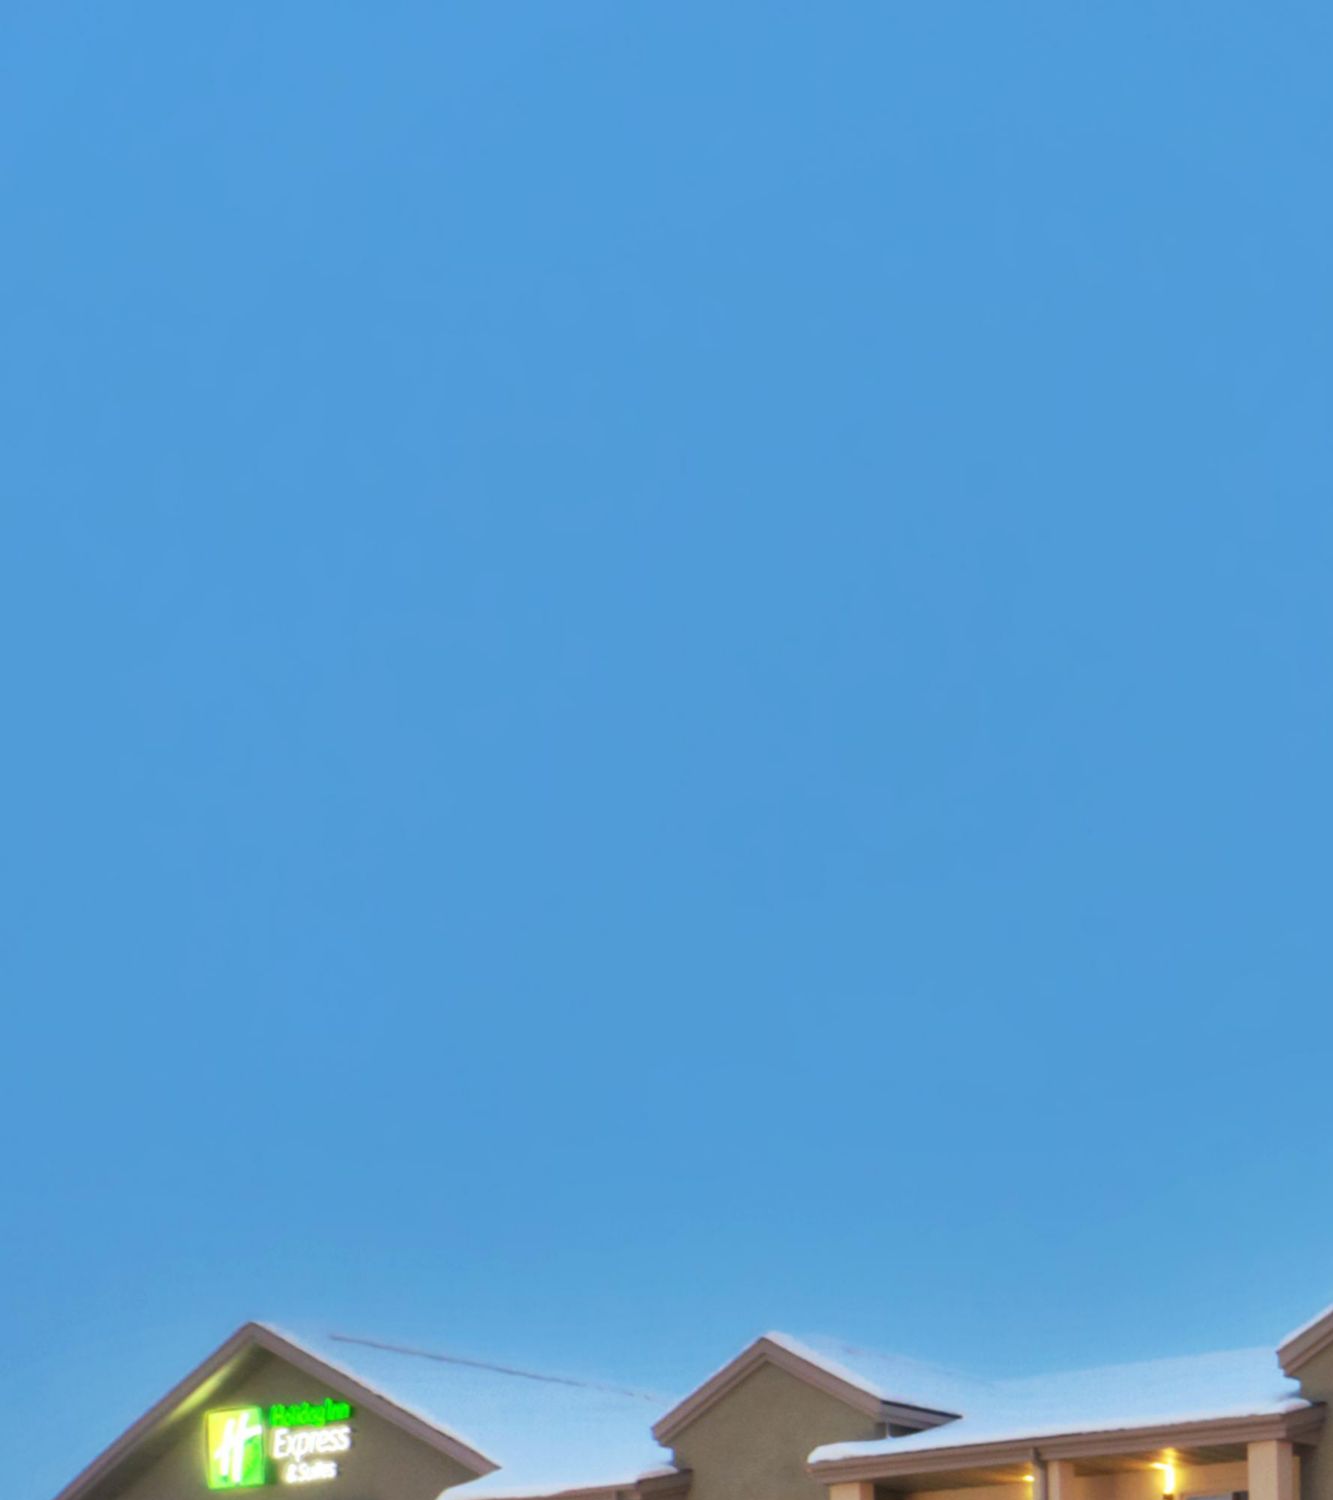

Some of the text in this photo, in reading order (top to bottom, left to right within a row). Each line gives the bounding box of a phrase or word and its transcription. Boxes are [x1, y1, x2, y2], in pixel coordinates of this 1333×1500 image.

[270, 1398, 350, 1427] Holiday Inn
[273, 1425, 351, 1462] Express
